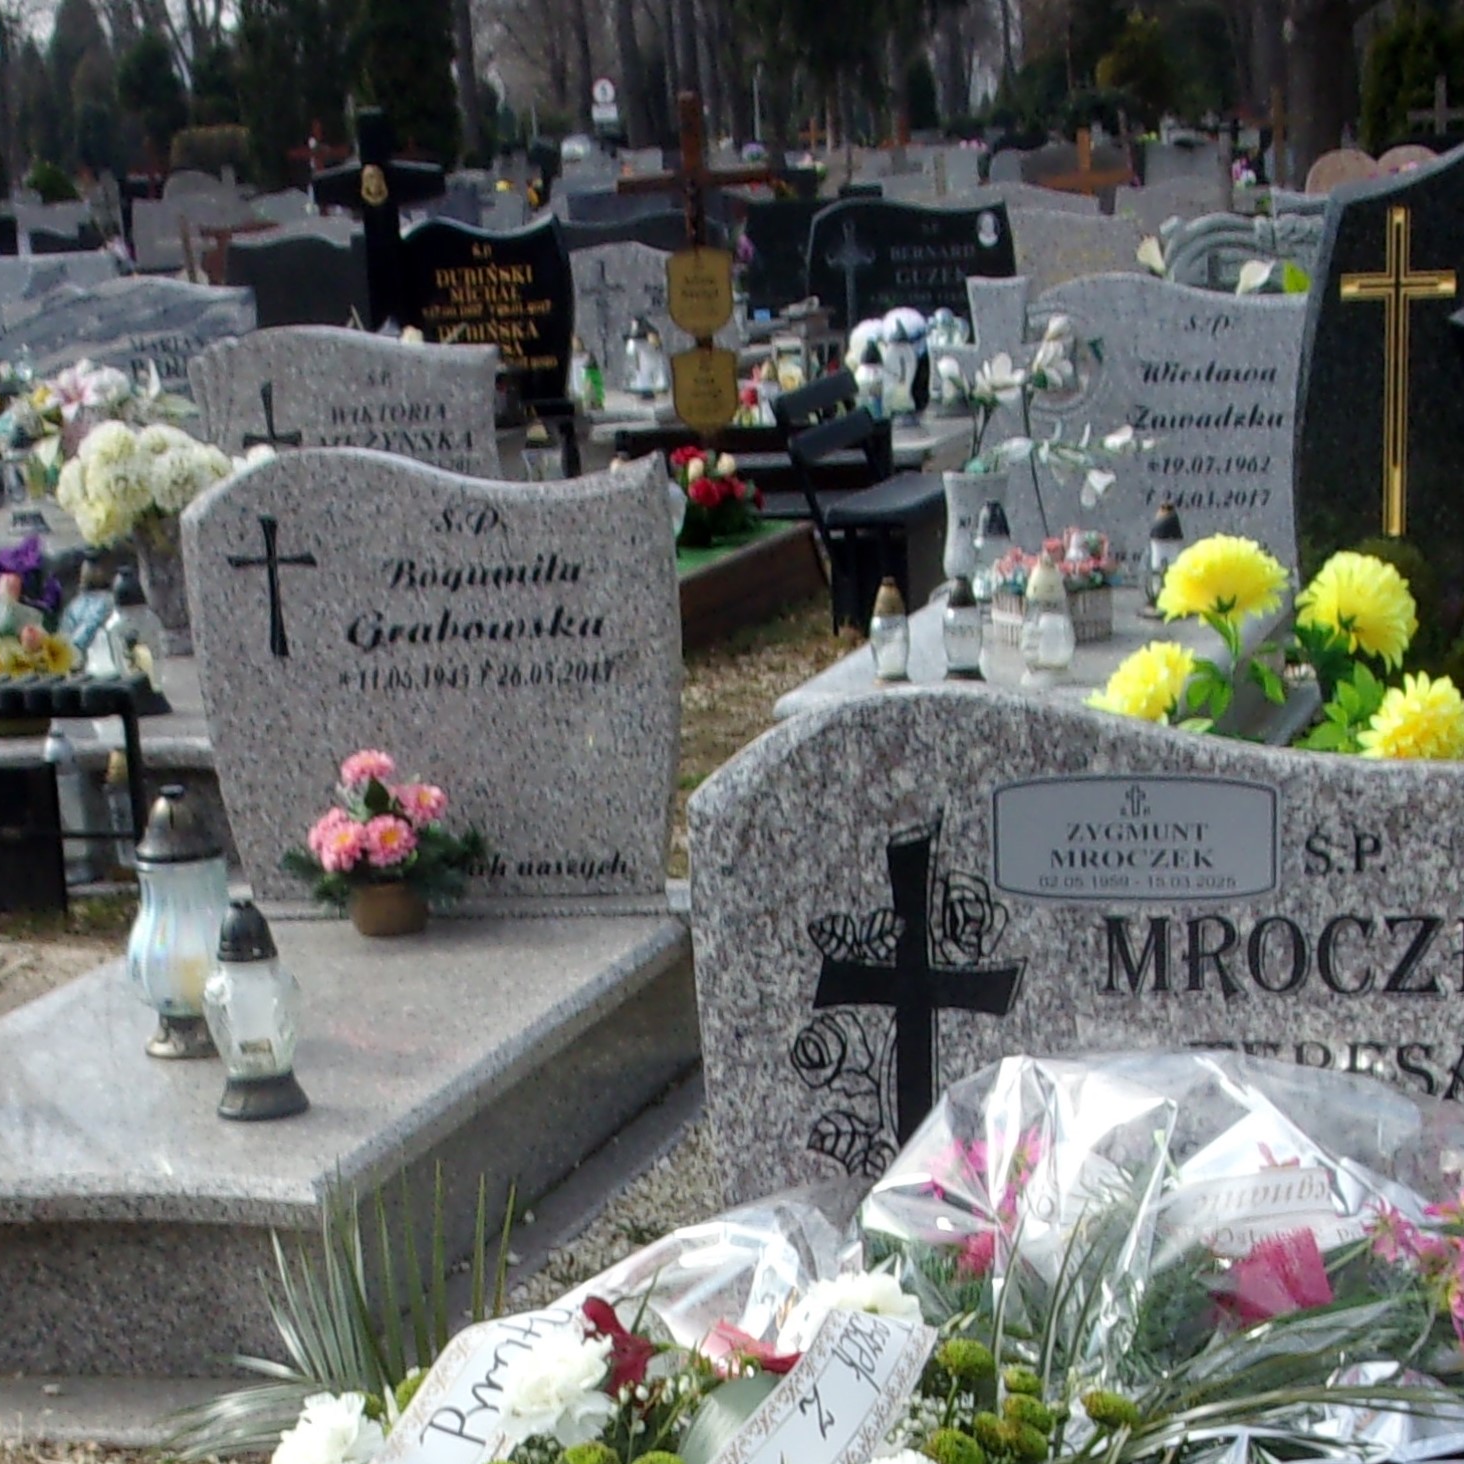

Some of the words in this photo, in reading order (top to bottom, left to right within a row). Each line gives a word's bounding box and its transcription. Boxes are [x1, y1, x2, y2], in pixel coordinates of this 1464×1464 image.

[346, 605, 606, 652] Grabowska
[1065, 822, 1209, 842] ZYGMUNT
[1050, 848, 1214, 869] MROCZEK
